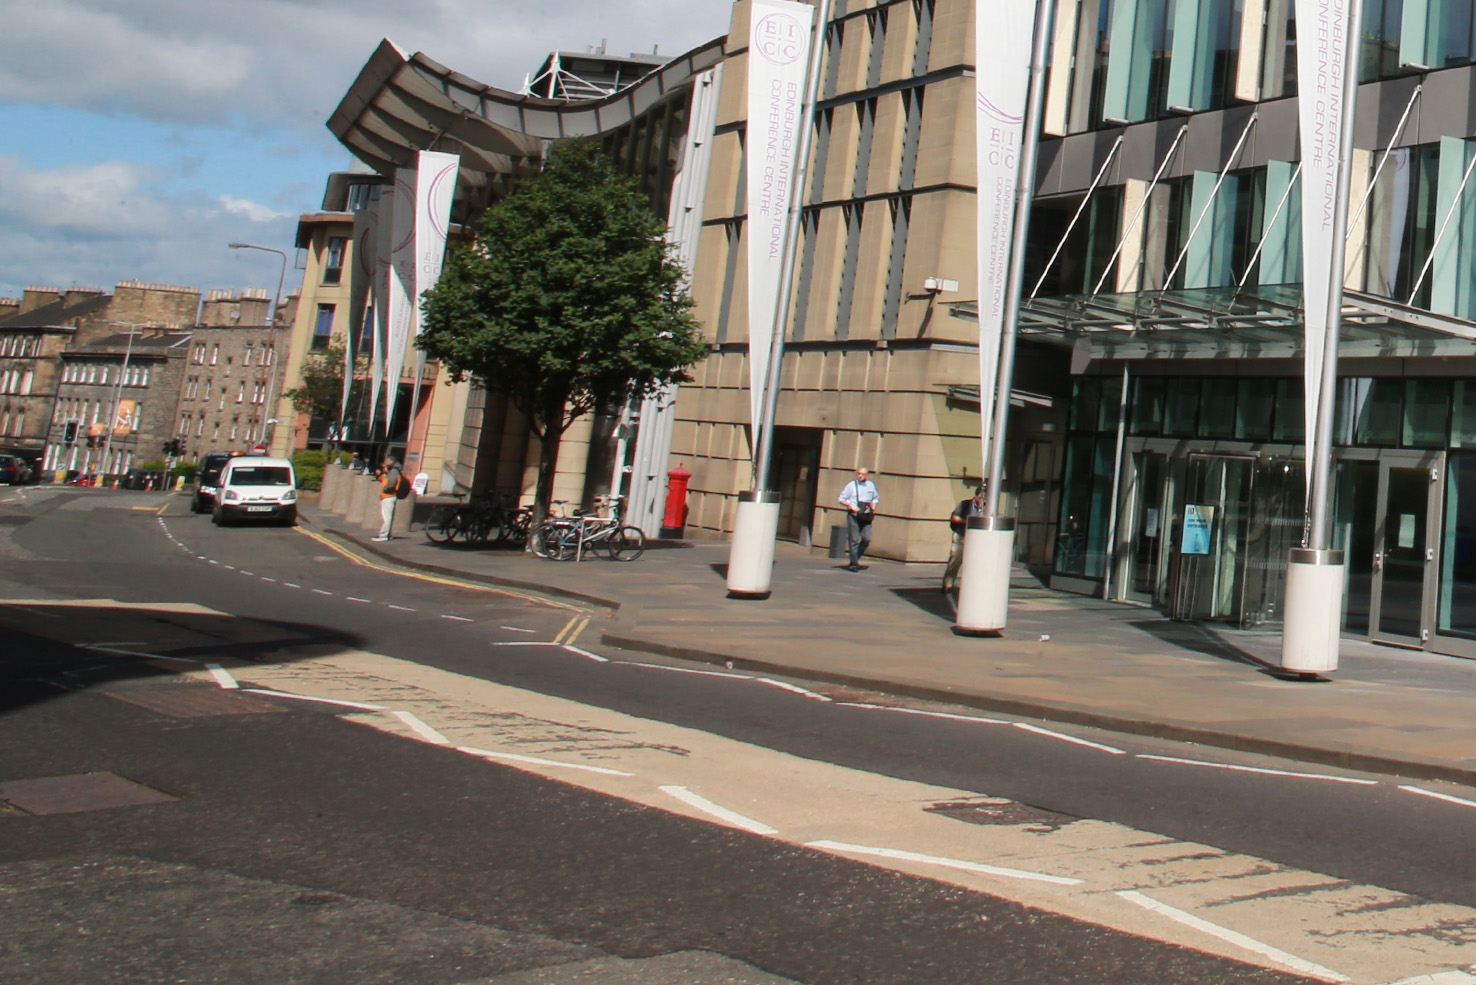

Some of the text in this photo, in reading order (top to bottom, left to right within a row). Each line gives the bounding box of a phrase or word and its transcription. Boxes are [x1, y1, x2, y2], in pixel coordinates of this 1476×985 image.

[760, 79, 782, 217] CONFERENCE CENTRE
[768, 82, 798, 262] EDINBURGH INTERNATIONAL
[1313, 100, 1326, 169] CENTRE
[1322, 93, 1340, 233] INTERNATIONAL
[992, 176, 1003, 242] CONFERENCE
[992, 178, 1012, 318] EDINBURGH INTERNATIONAL
